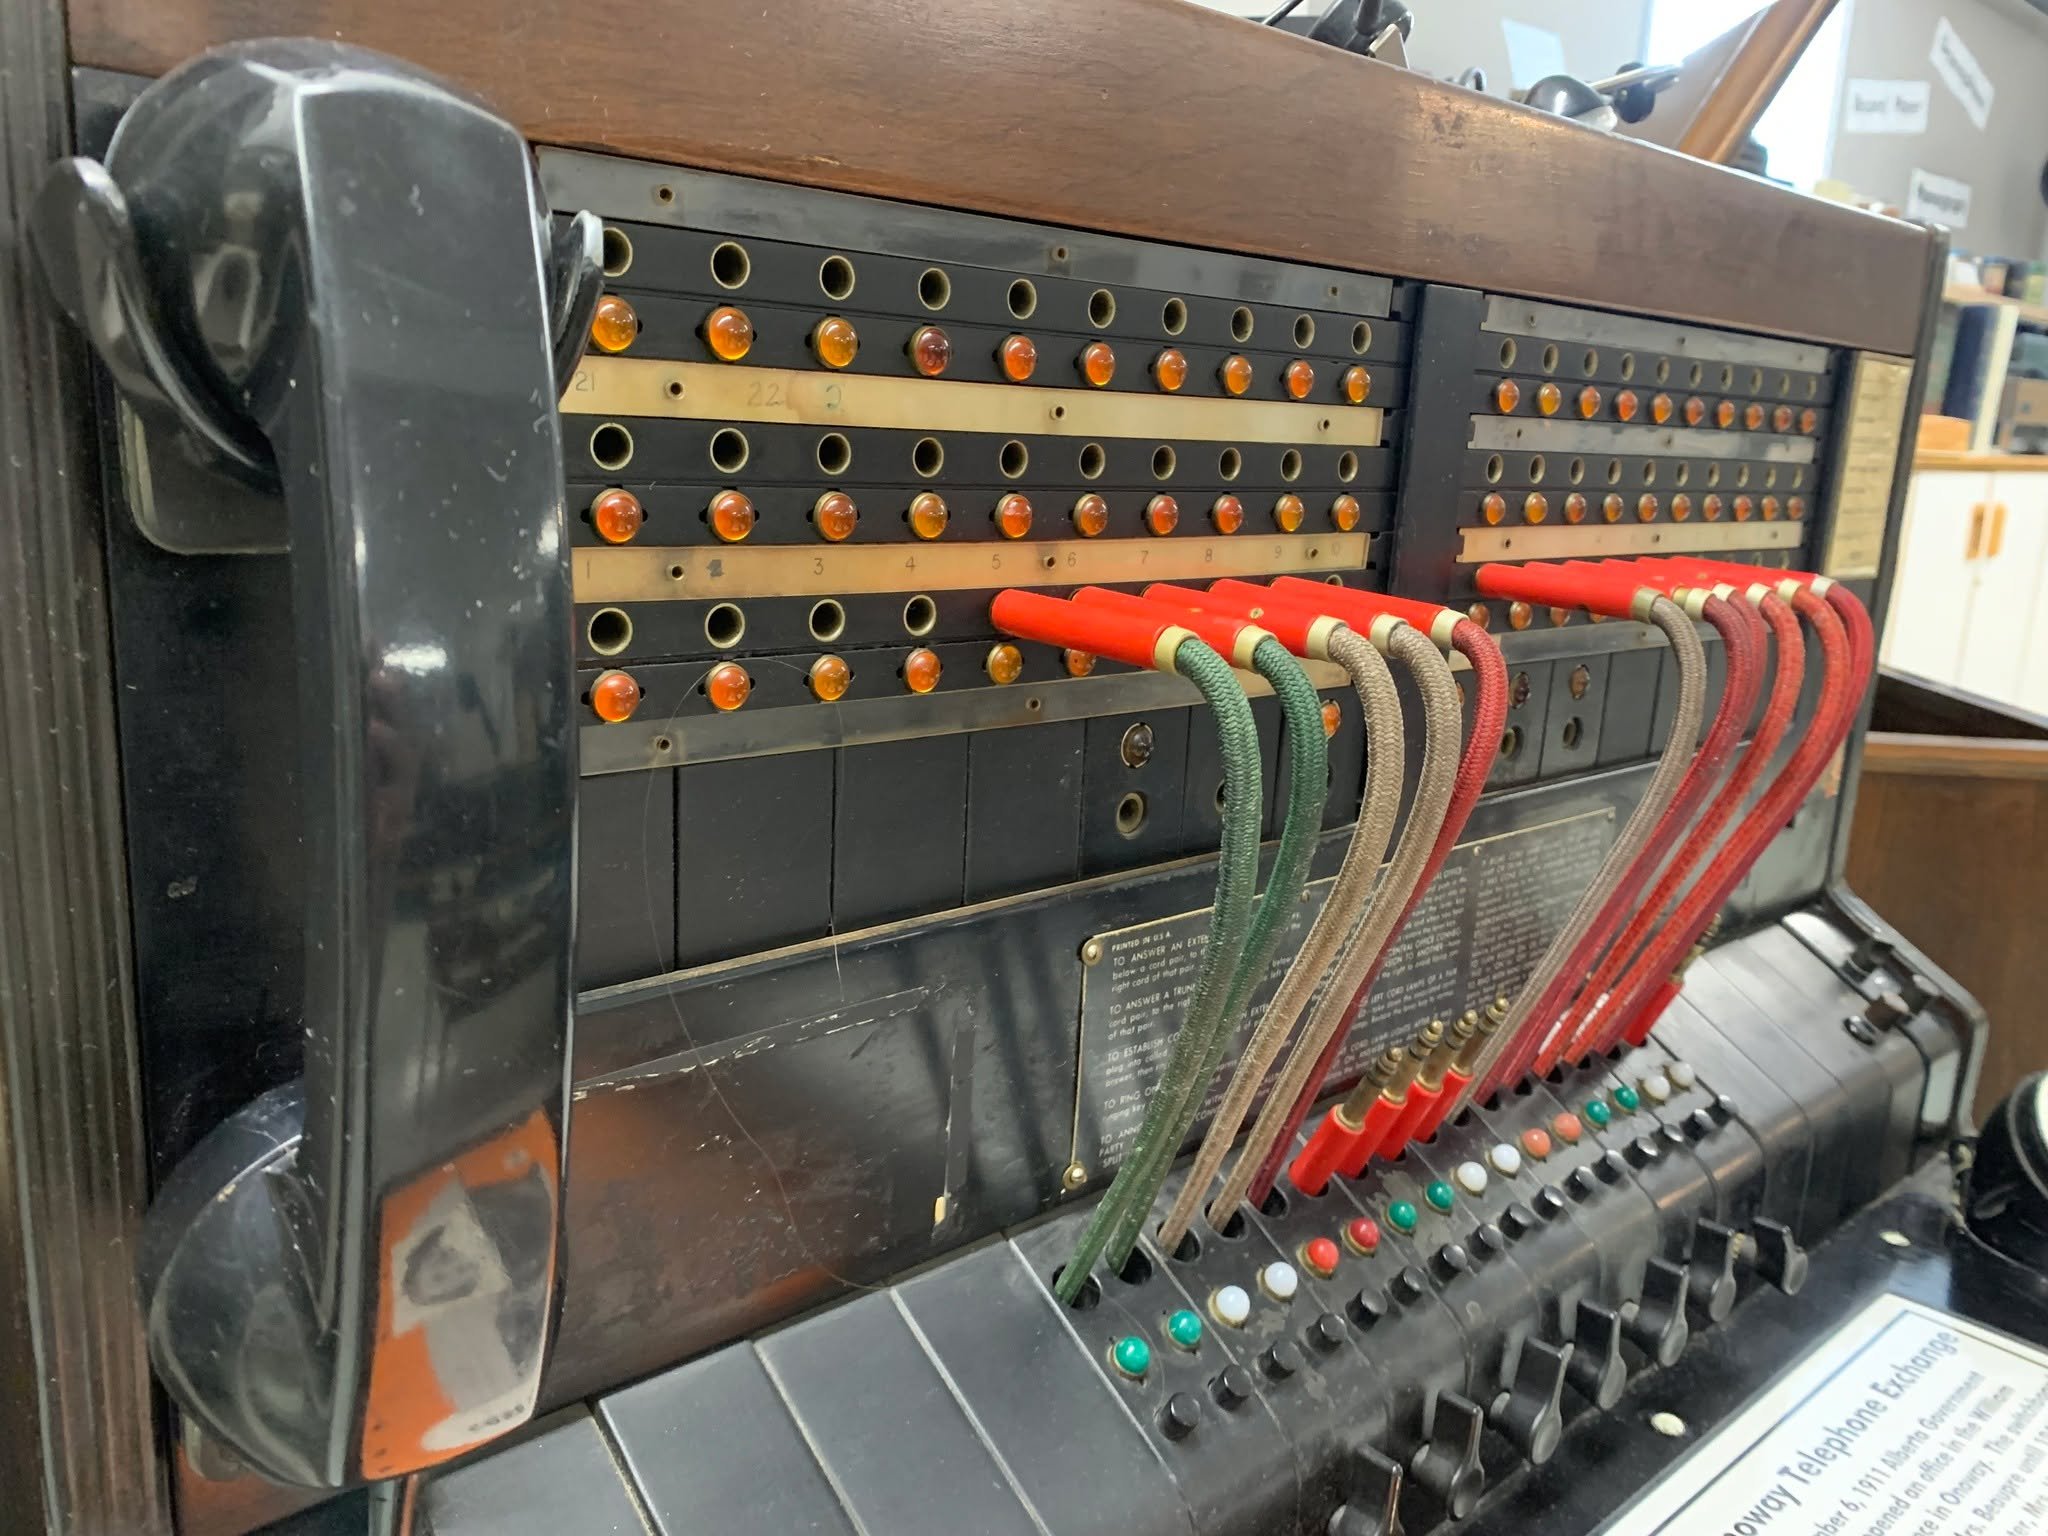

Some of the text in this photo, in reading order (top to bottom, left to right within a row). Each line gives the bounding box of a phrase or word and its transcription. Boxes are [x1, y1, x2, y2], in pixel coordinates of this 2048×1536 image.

[575, 370, 595, 392] 21
[747, 381, 783, 408] 22
[813, 557, 825, 576] 3
[904, 555, 917, 575] 4
[991, 552, 1002, 570] 5
[1066, 550, 1078, 568] 6
[1140, 549, 1150, 566] 7
[1204, 547, 1214, 563] 8
[1274, 544, 1283, 560] 9
[1111, 938, 1140, 952] PRINTED
[1113, 955, 1126, 967] TO
[1130, 944, 1167, 963] ANSWER
[1171, 940, 1184, 952] AN
[1112, 967, 1137, 981] below
[1149, 957, 1166, 971] cord
[1111, 980, 1131, 994] right
[1132, 976, 1150, 988] cord
[1109, 1003, 1122, 1016] TO
[1125, 992, 1161, 1011] ANSWER
[1107, 1051, 1120, 1063] TO
[1123, 1037, 1164, 1058] ESTABLISH
[1104, 1098, 1117, 1110] TO
[1723, 1331, 1959, 1536] oway Telephone Exchange
[1851, 1466, 1892, 1498] 1911
[1880, 1430, 1930, 1472] Alberta
[1904, 1481, 1927, 1500] an
